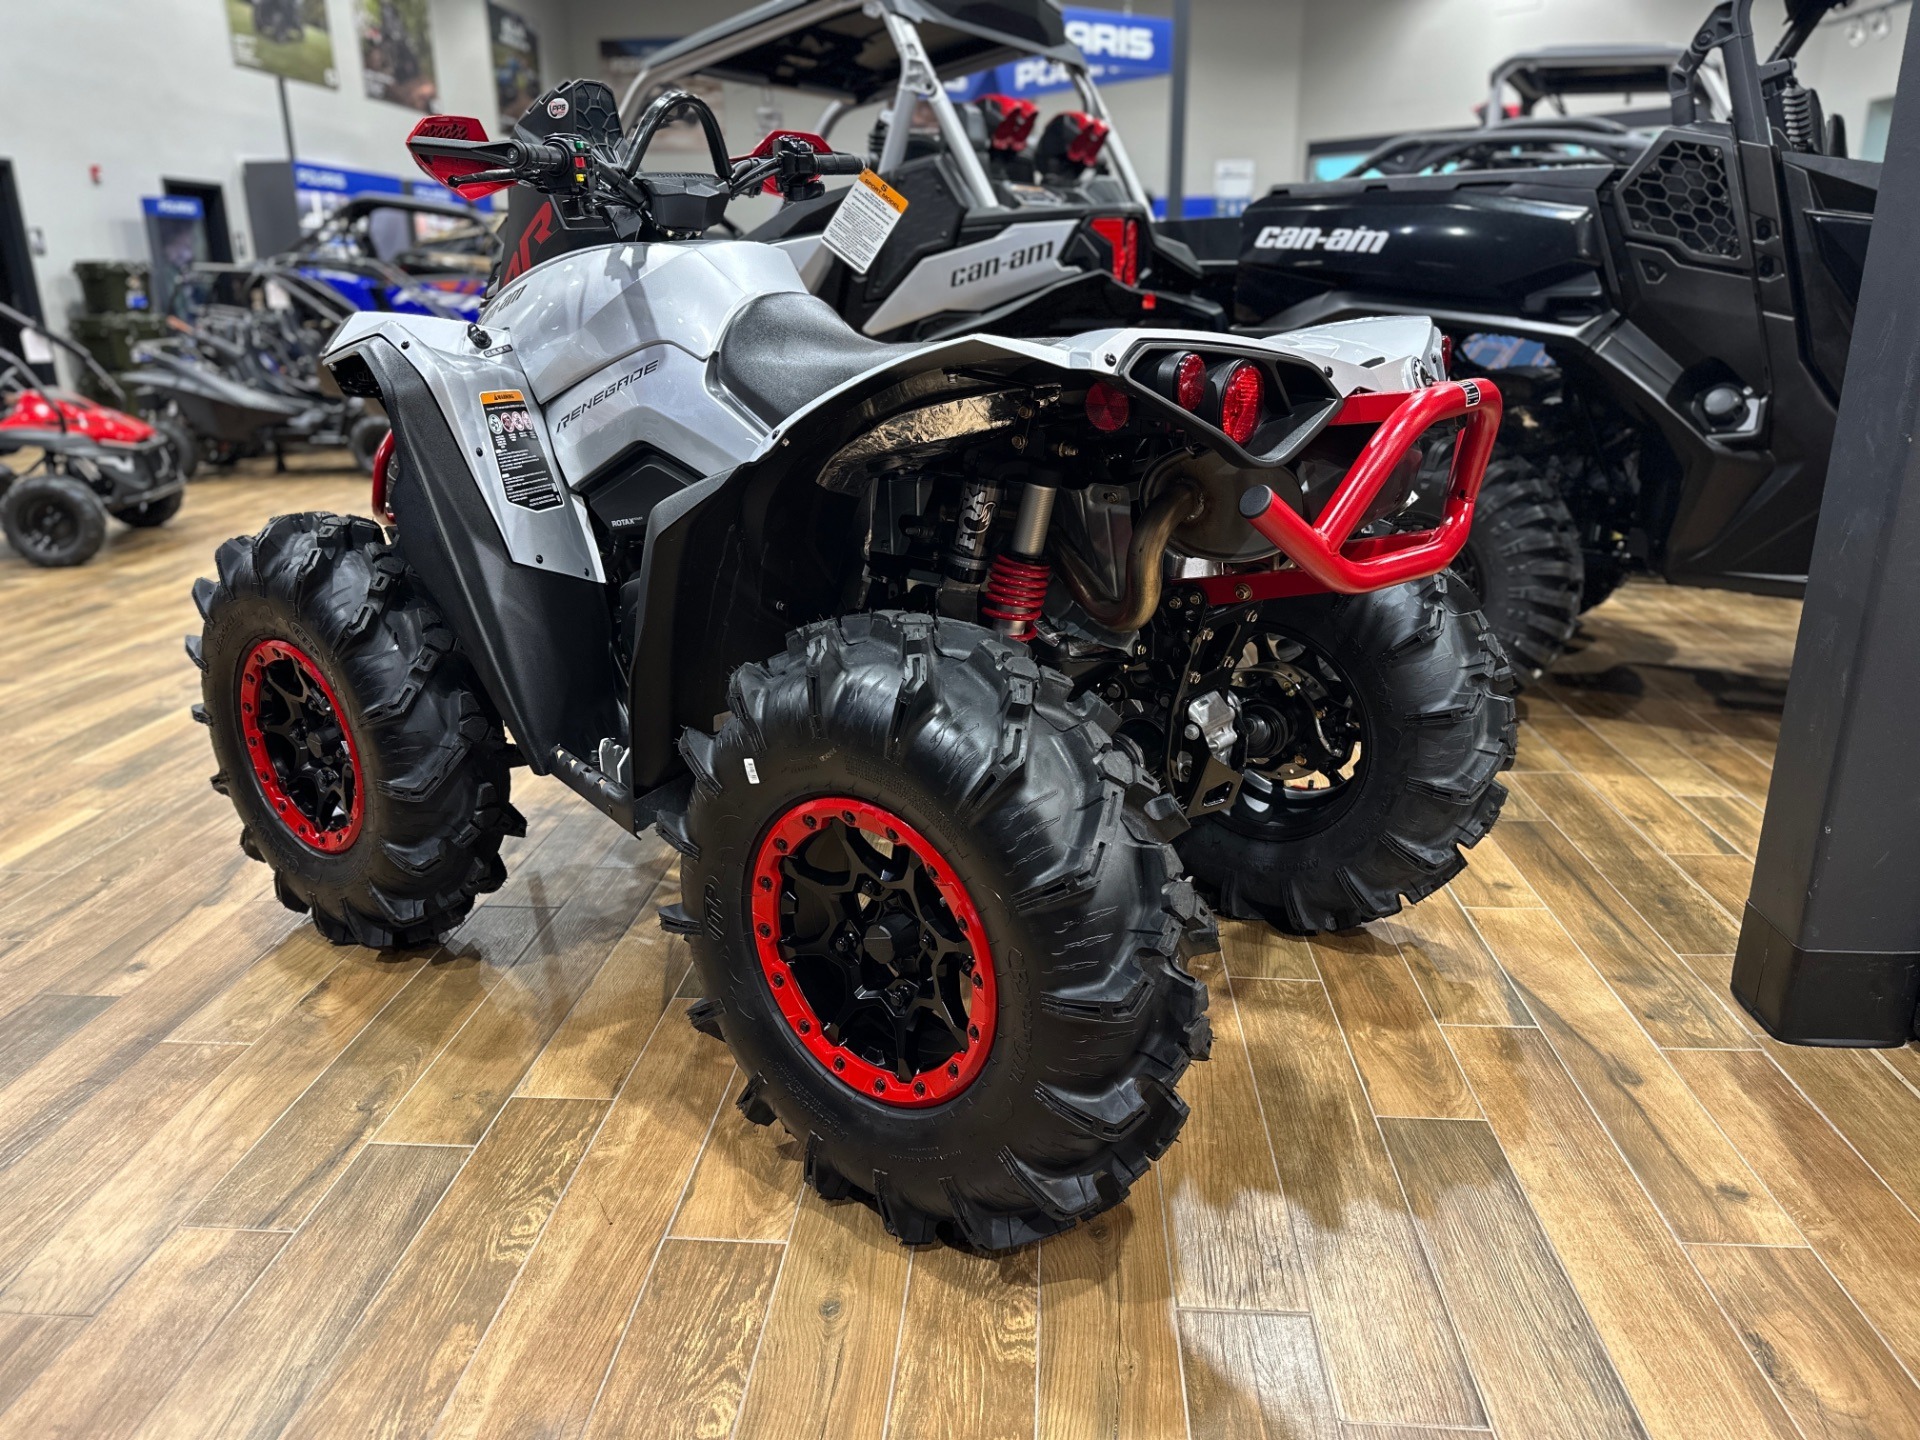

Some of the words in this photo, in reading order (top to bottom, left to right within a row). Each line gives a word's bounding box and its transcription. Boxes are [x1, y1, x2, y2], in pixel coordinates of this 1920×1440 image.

[1064, 21, 1154, 60] ARIS
[865, 178, 882, 195] SPORT
[882, 193, 900, 211] MODEL
[1254, 225, 1389, 254] can-am
[950, 240, 1054, 288] can-am
[556, 360, 659, 433] RENEGADE
[611, 519, 635, 527] ROTAX
[957, 487, 988, 551] FOX
